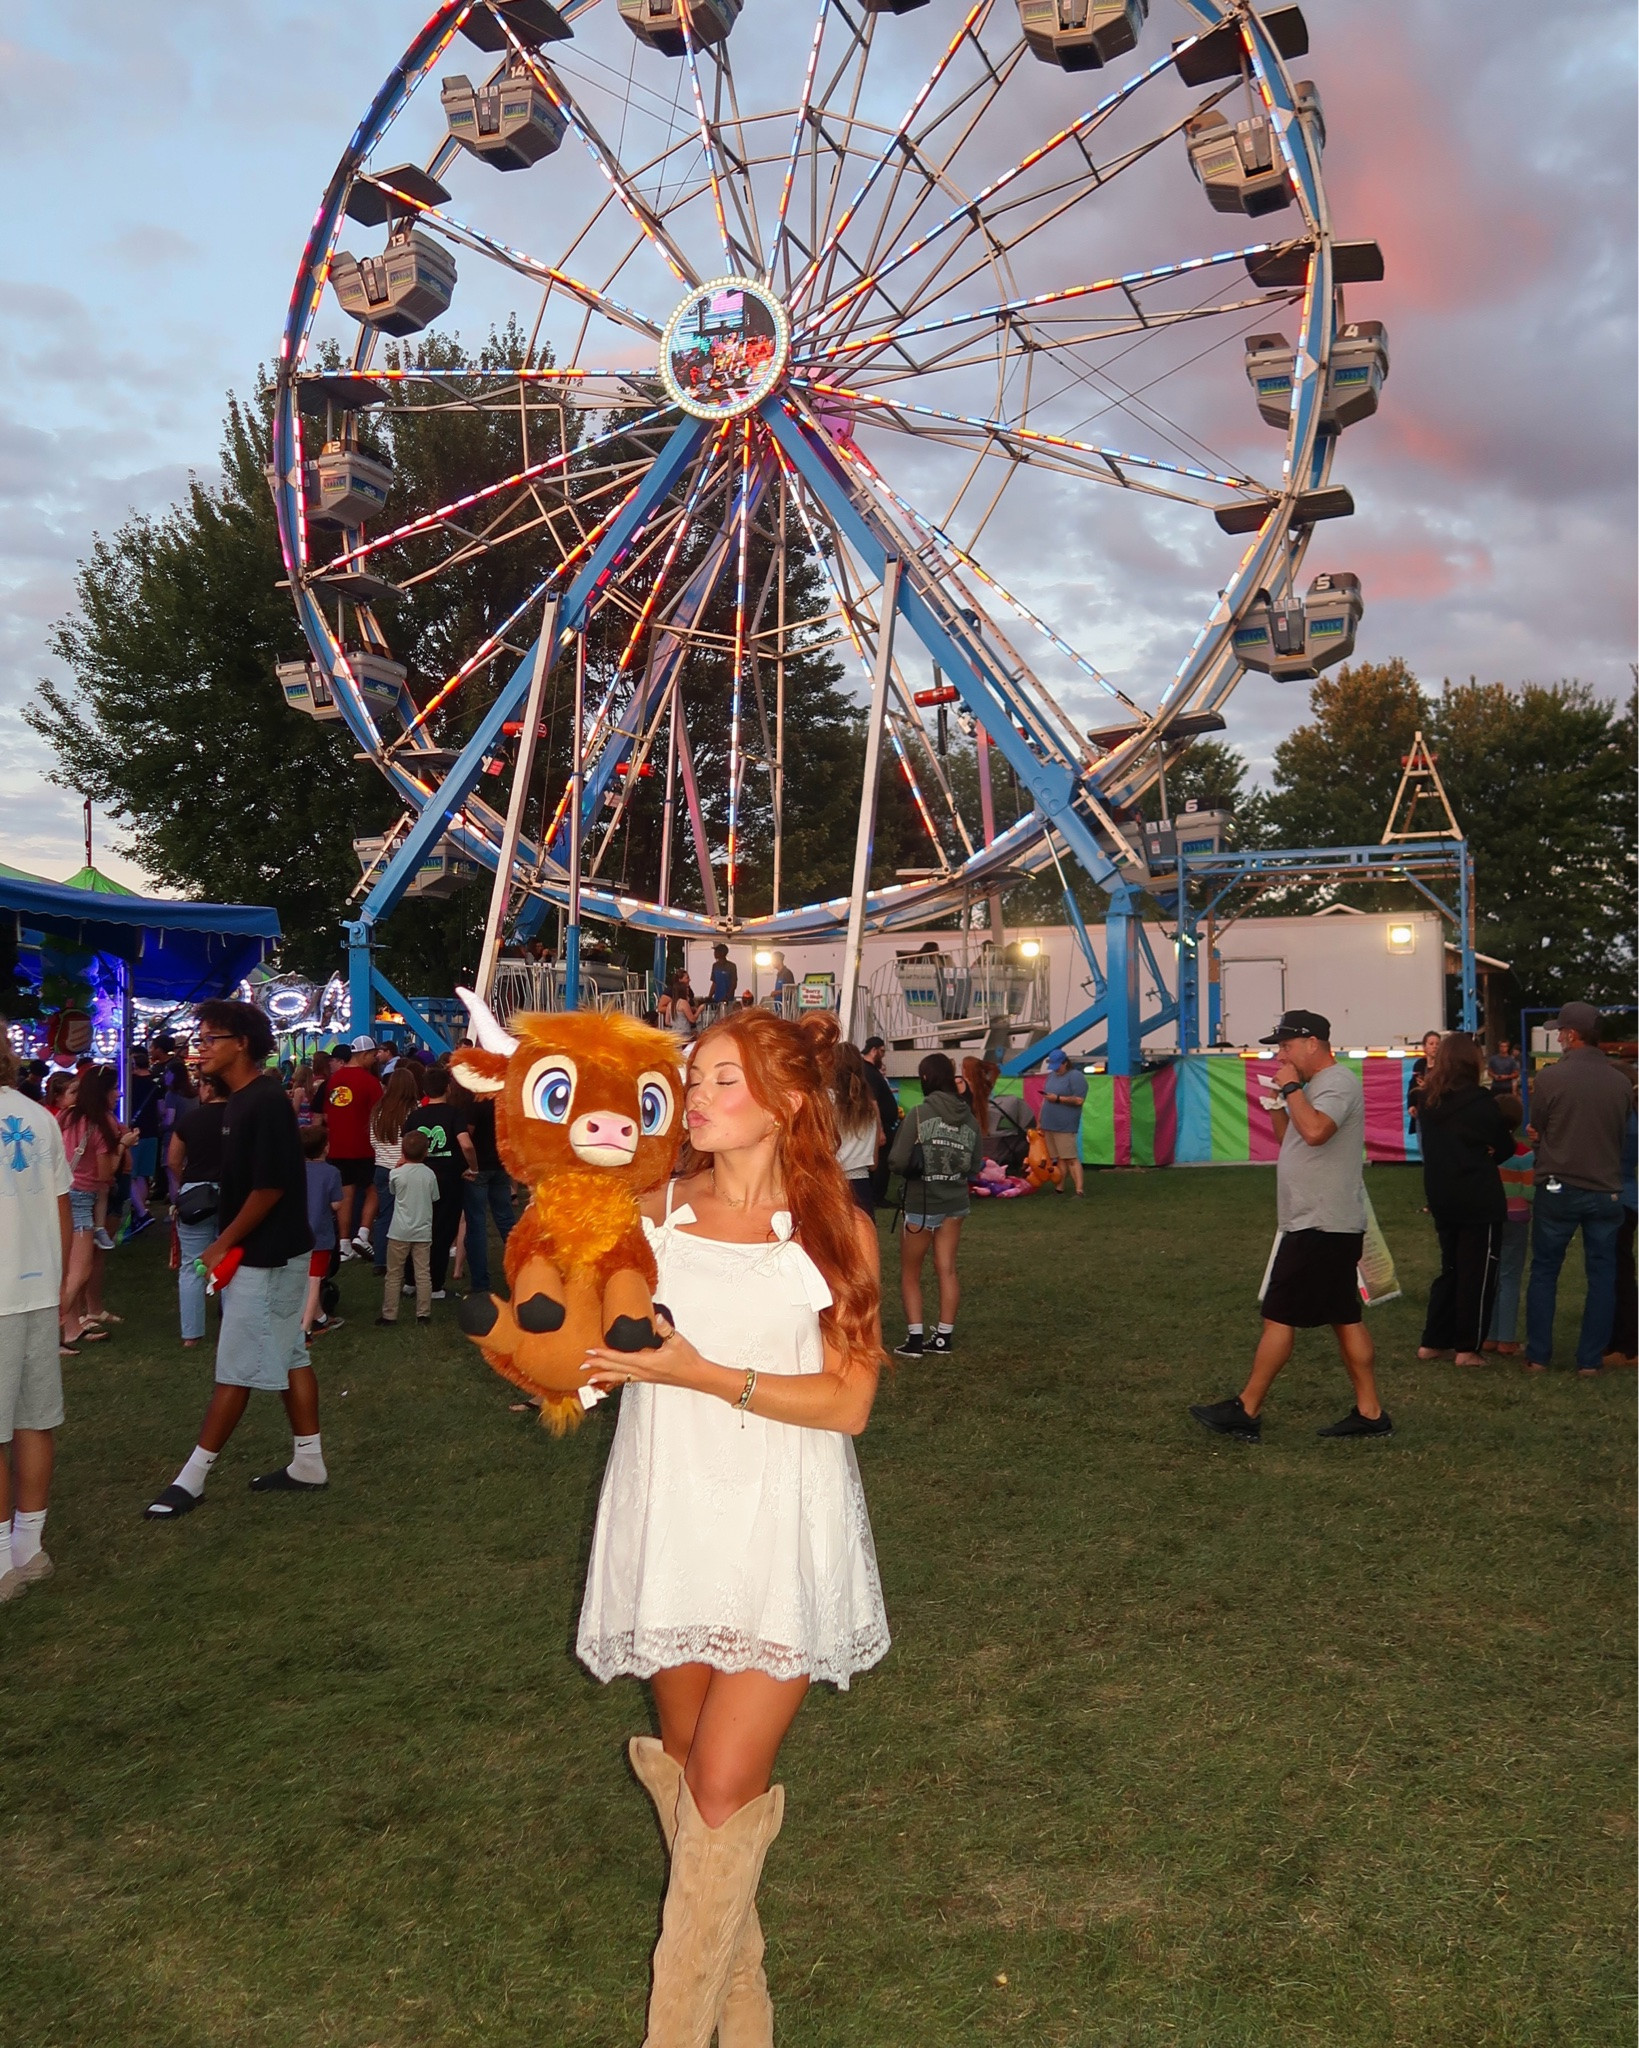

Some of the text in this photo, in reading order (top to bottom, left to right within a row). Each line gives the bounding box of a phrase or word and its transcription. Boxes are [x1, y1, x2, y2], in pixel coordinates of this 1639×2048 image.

[511, 66, 525, 78] 14
[391, 233, 405, 247] 13
[1344, 324, 1359, 337] 4
[327, 441, 341, 453] 12
[1316, 576, 1330, 590] 5
[1185, 799, 1198, 812] 6
